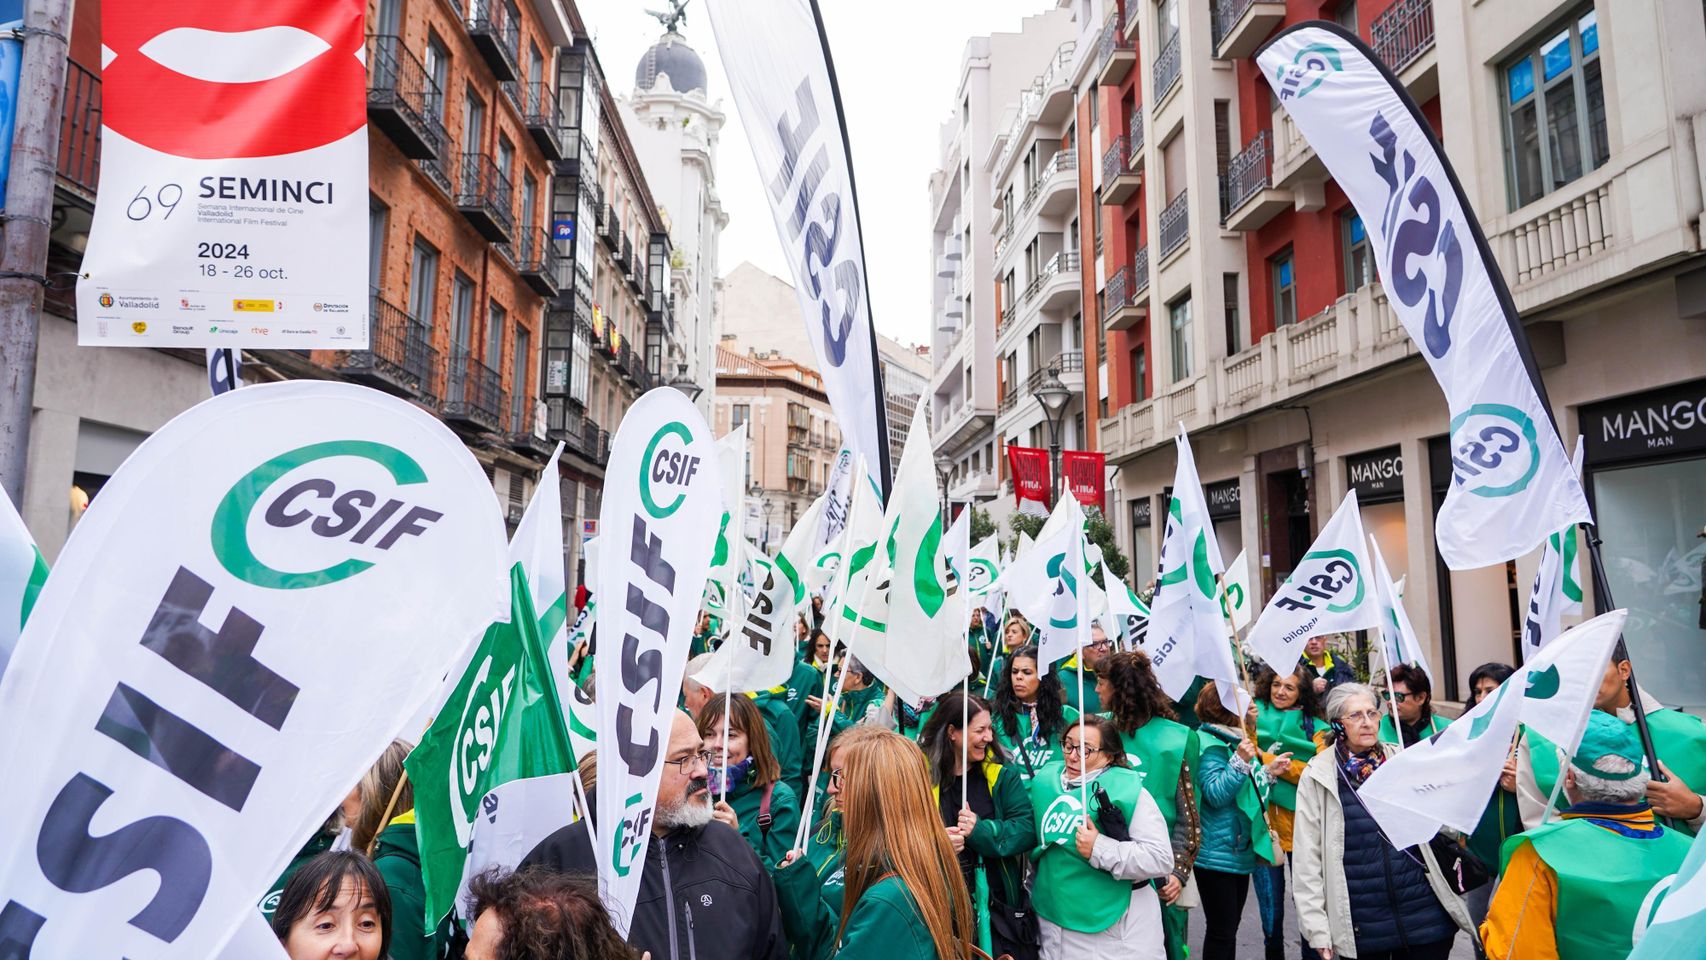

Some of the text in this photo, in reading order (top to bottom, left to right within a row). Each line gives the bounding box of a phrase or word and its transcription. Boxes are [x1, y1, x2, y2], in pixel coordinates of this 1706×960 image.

[198, 176, 333, 204] SEMINCI
[126, 184, 183, 221] 69
[229, 204, 275, 213] Internacional
[197, 217, 241, 225] International
[198, 242, 250, 260] 2024
[199, 264, 217, 277] 18
[234, 265, 254, 278] 26
[258, 267, 288, 280] oct.
[118, 300, 160, 309] Valladolid
[251, 326, 269, 335] rtve
[1647, 435, 1674, 449] MAN
[652, 448, 701, 487] CSIF
[1351, 455, 1404, 483] MANGO
[264, 478, 444, 551] CSIF
[616, 513, 676, 779] CSIF
[0, 564, 301, 960] SIF
